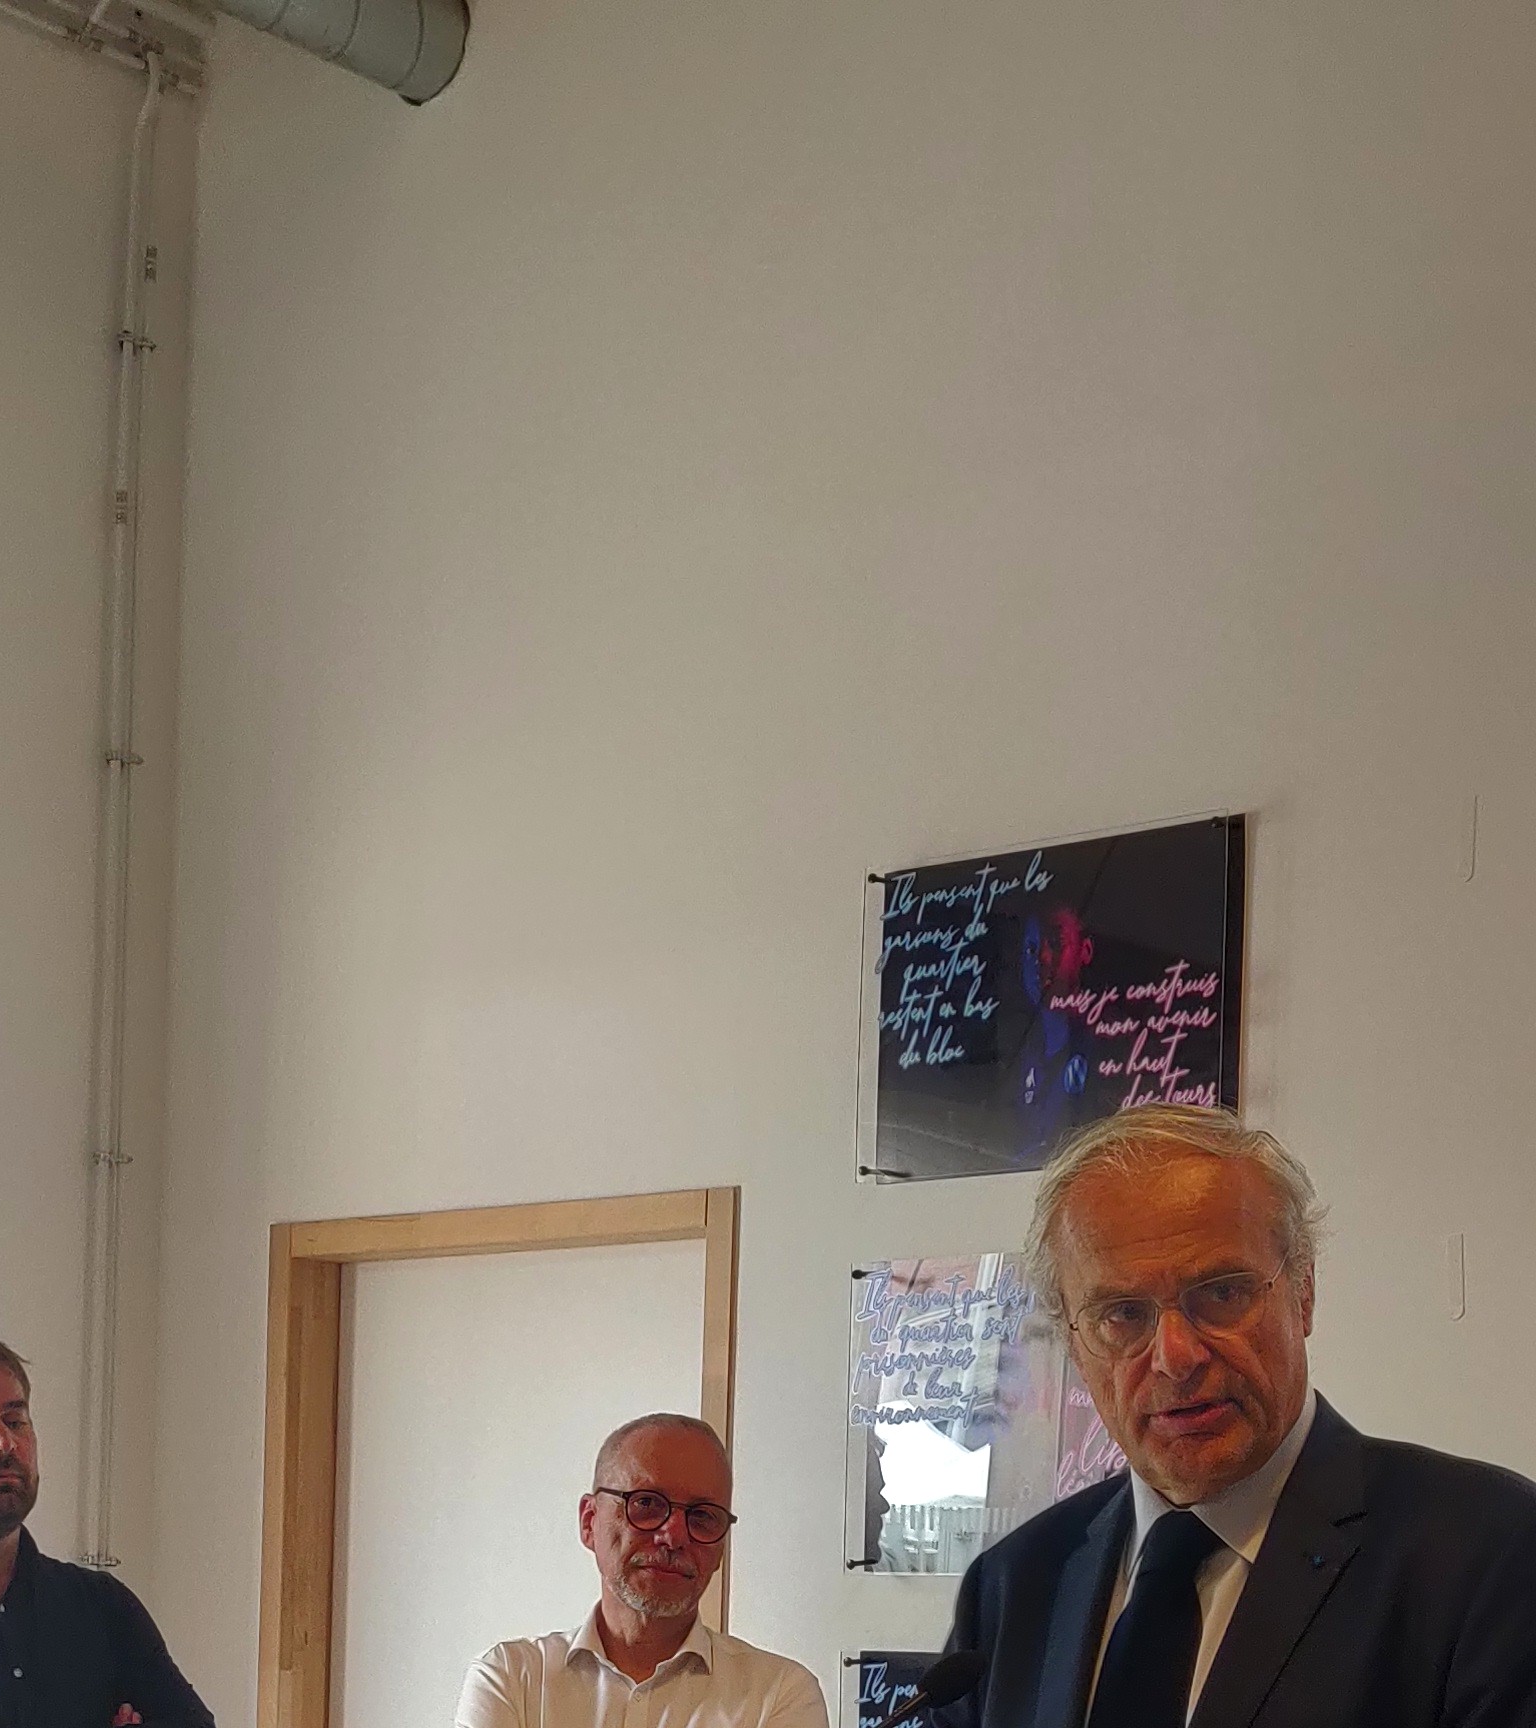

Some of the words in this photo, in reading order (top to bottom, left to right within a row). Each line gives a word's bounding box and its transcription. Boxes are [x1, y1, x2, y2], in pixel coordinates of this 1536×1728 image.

[880, 872, 920, 921] Ils
[917, 861, 998, 926] pensent
[987, 876, 1021, 914] que
[1024, 850, 1055, 892] les
[965, 902, 989, 941] du
[899, 936, 987, 1005] quartier
[1049, 988, 1097, 1014] mais
[1086, 985, 1120, 1025] je
[1126, 958, 1220, 1015] construis
[939, 1001, 957, 1018] en
[963, 976, 1000, 1020] bas
[1095, 1017, 1140, 1036] mon
[1147, 1005, 1217, 1033] avenir
[899, 1028, 921, 1069] du
[925, 1024, 966, 1066] bloc
[1098, 1058, 1124, 1076] en
[1126, 1027, 1188, 1088] haut
[854, 1661, 892, 1704] Ils
